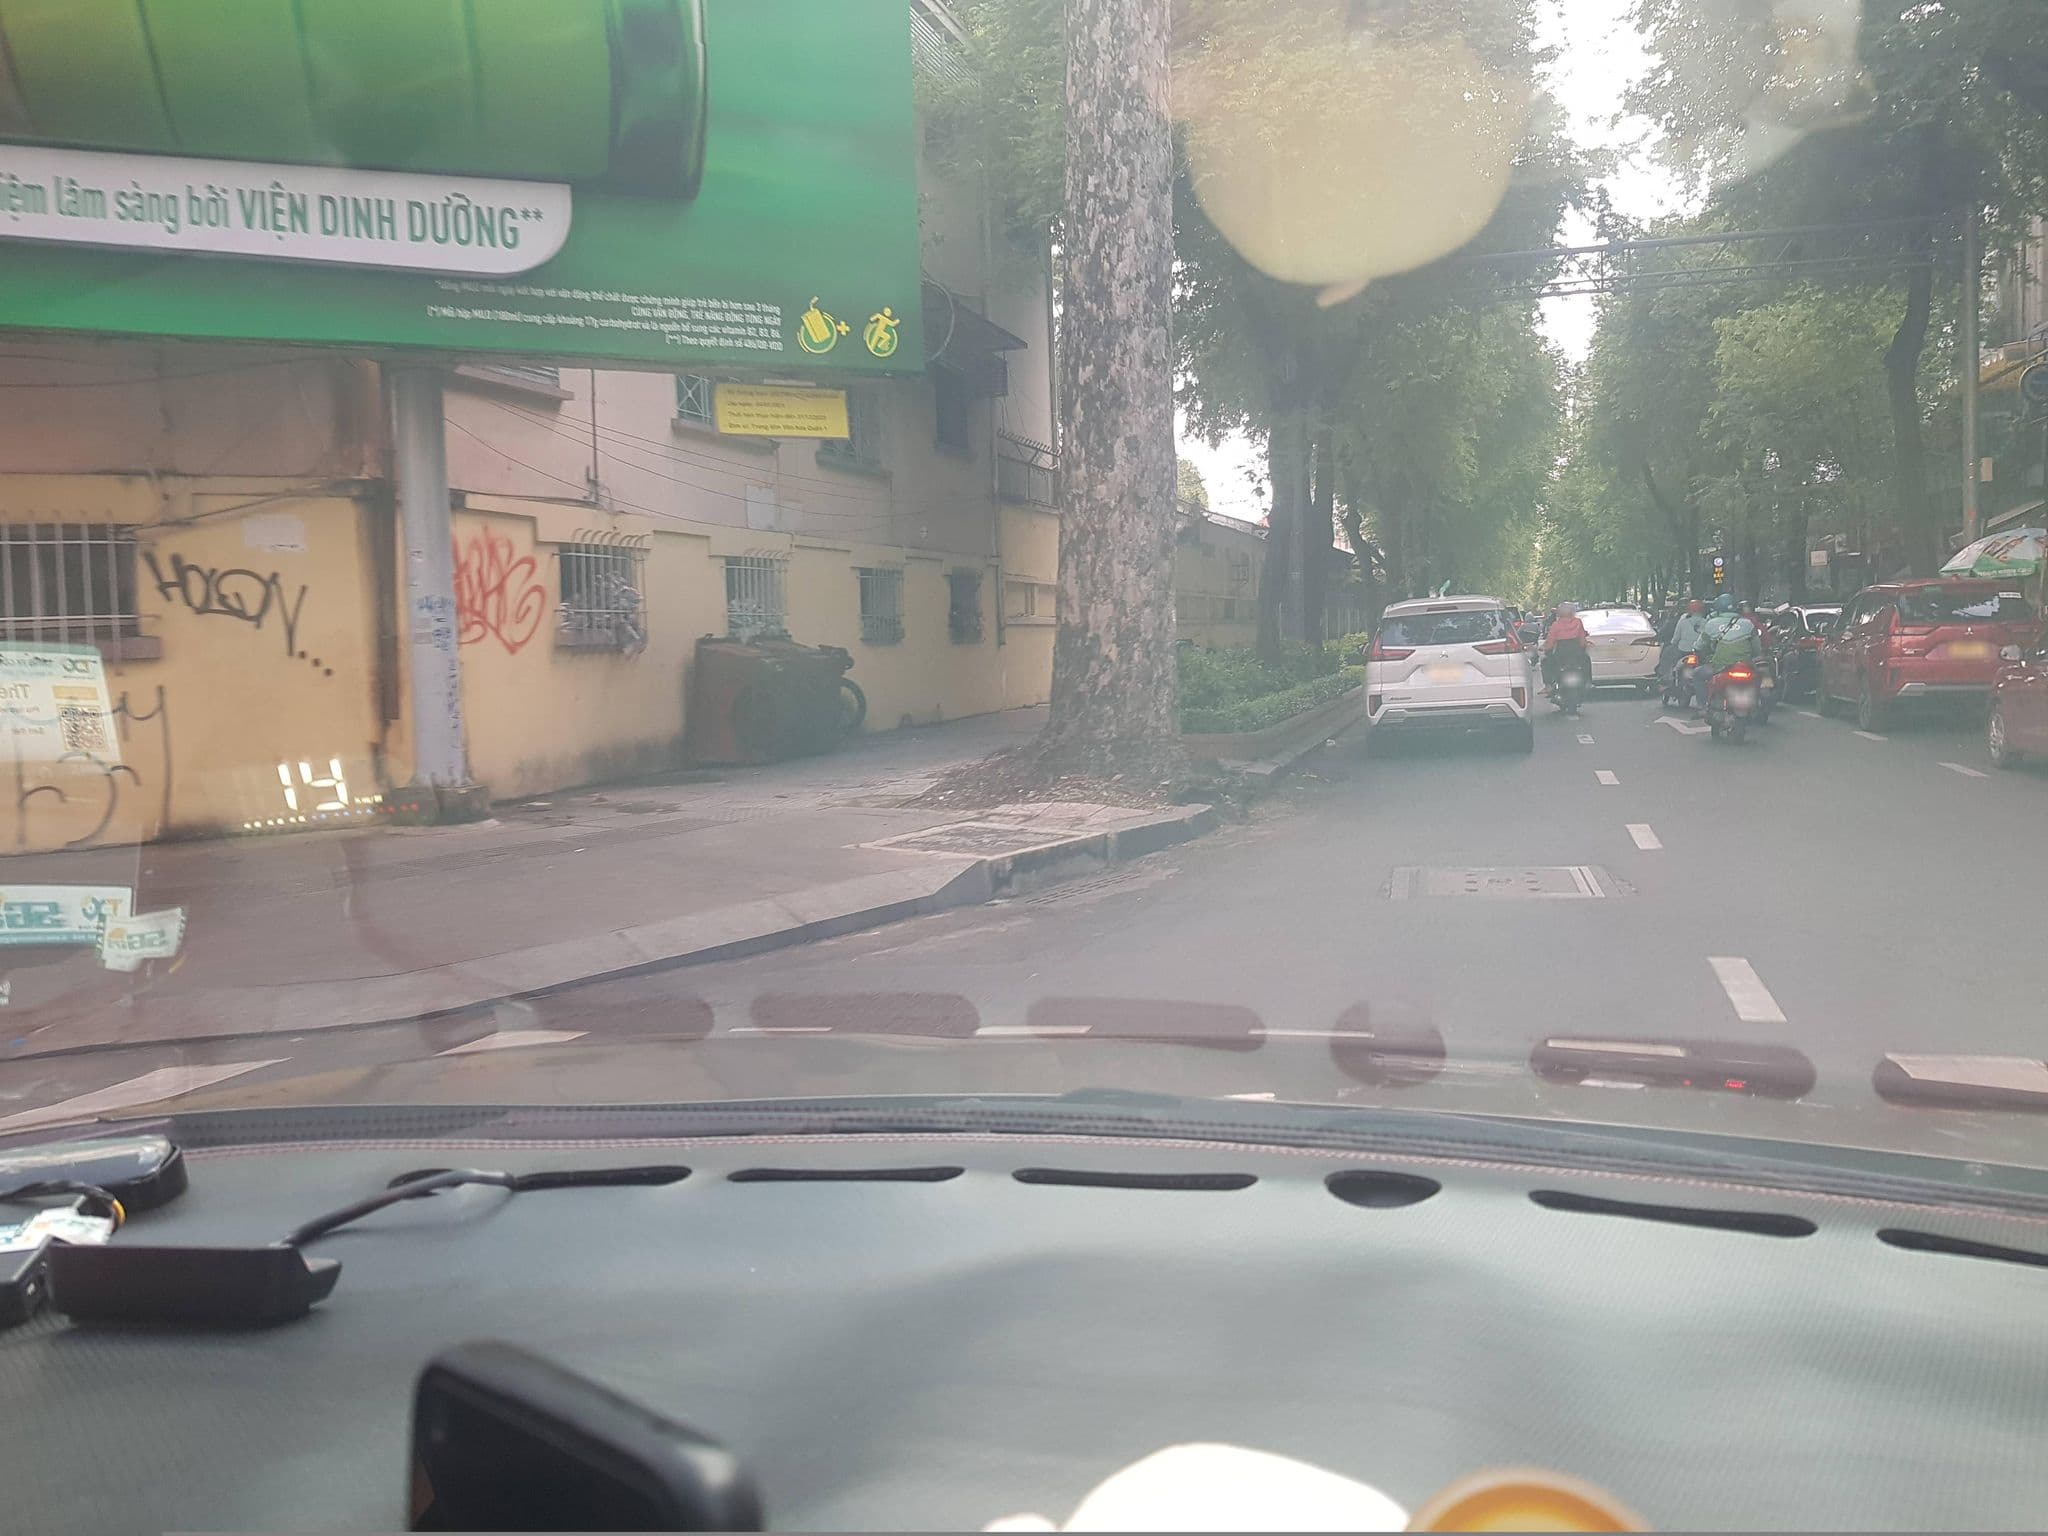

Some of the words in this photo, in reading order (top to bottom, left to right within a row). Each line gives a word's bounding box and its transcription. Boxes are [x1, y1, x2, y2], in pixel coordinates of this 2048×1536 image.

[54, 176, 106, 219] lâm
[186, 184, 229, 228] bởi
[236, 181, 309, 241] VIỆN
[320, 195, 395, 240] DINH
